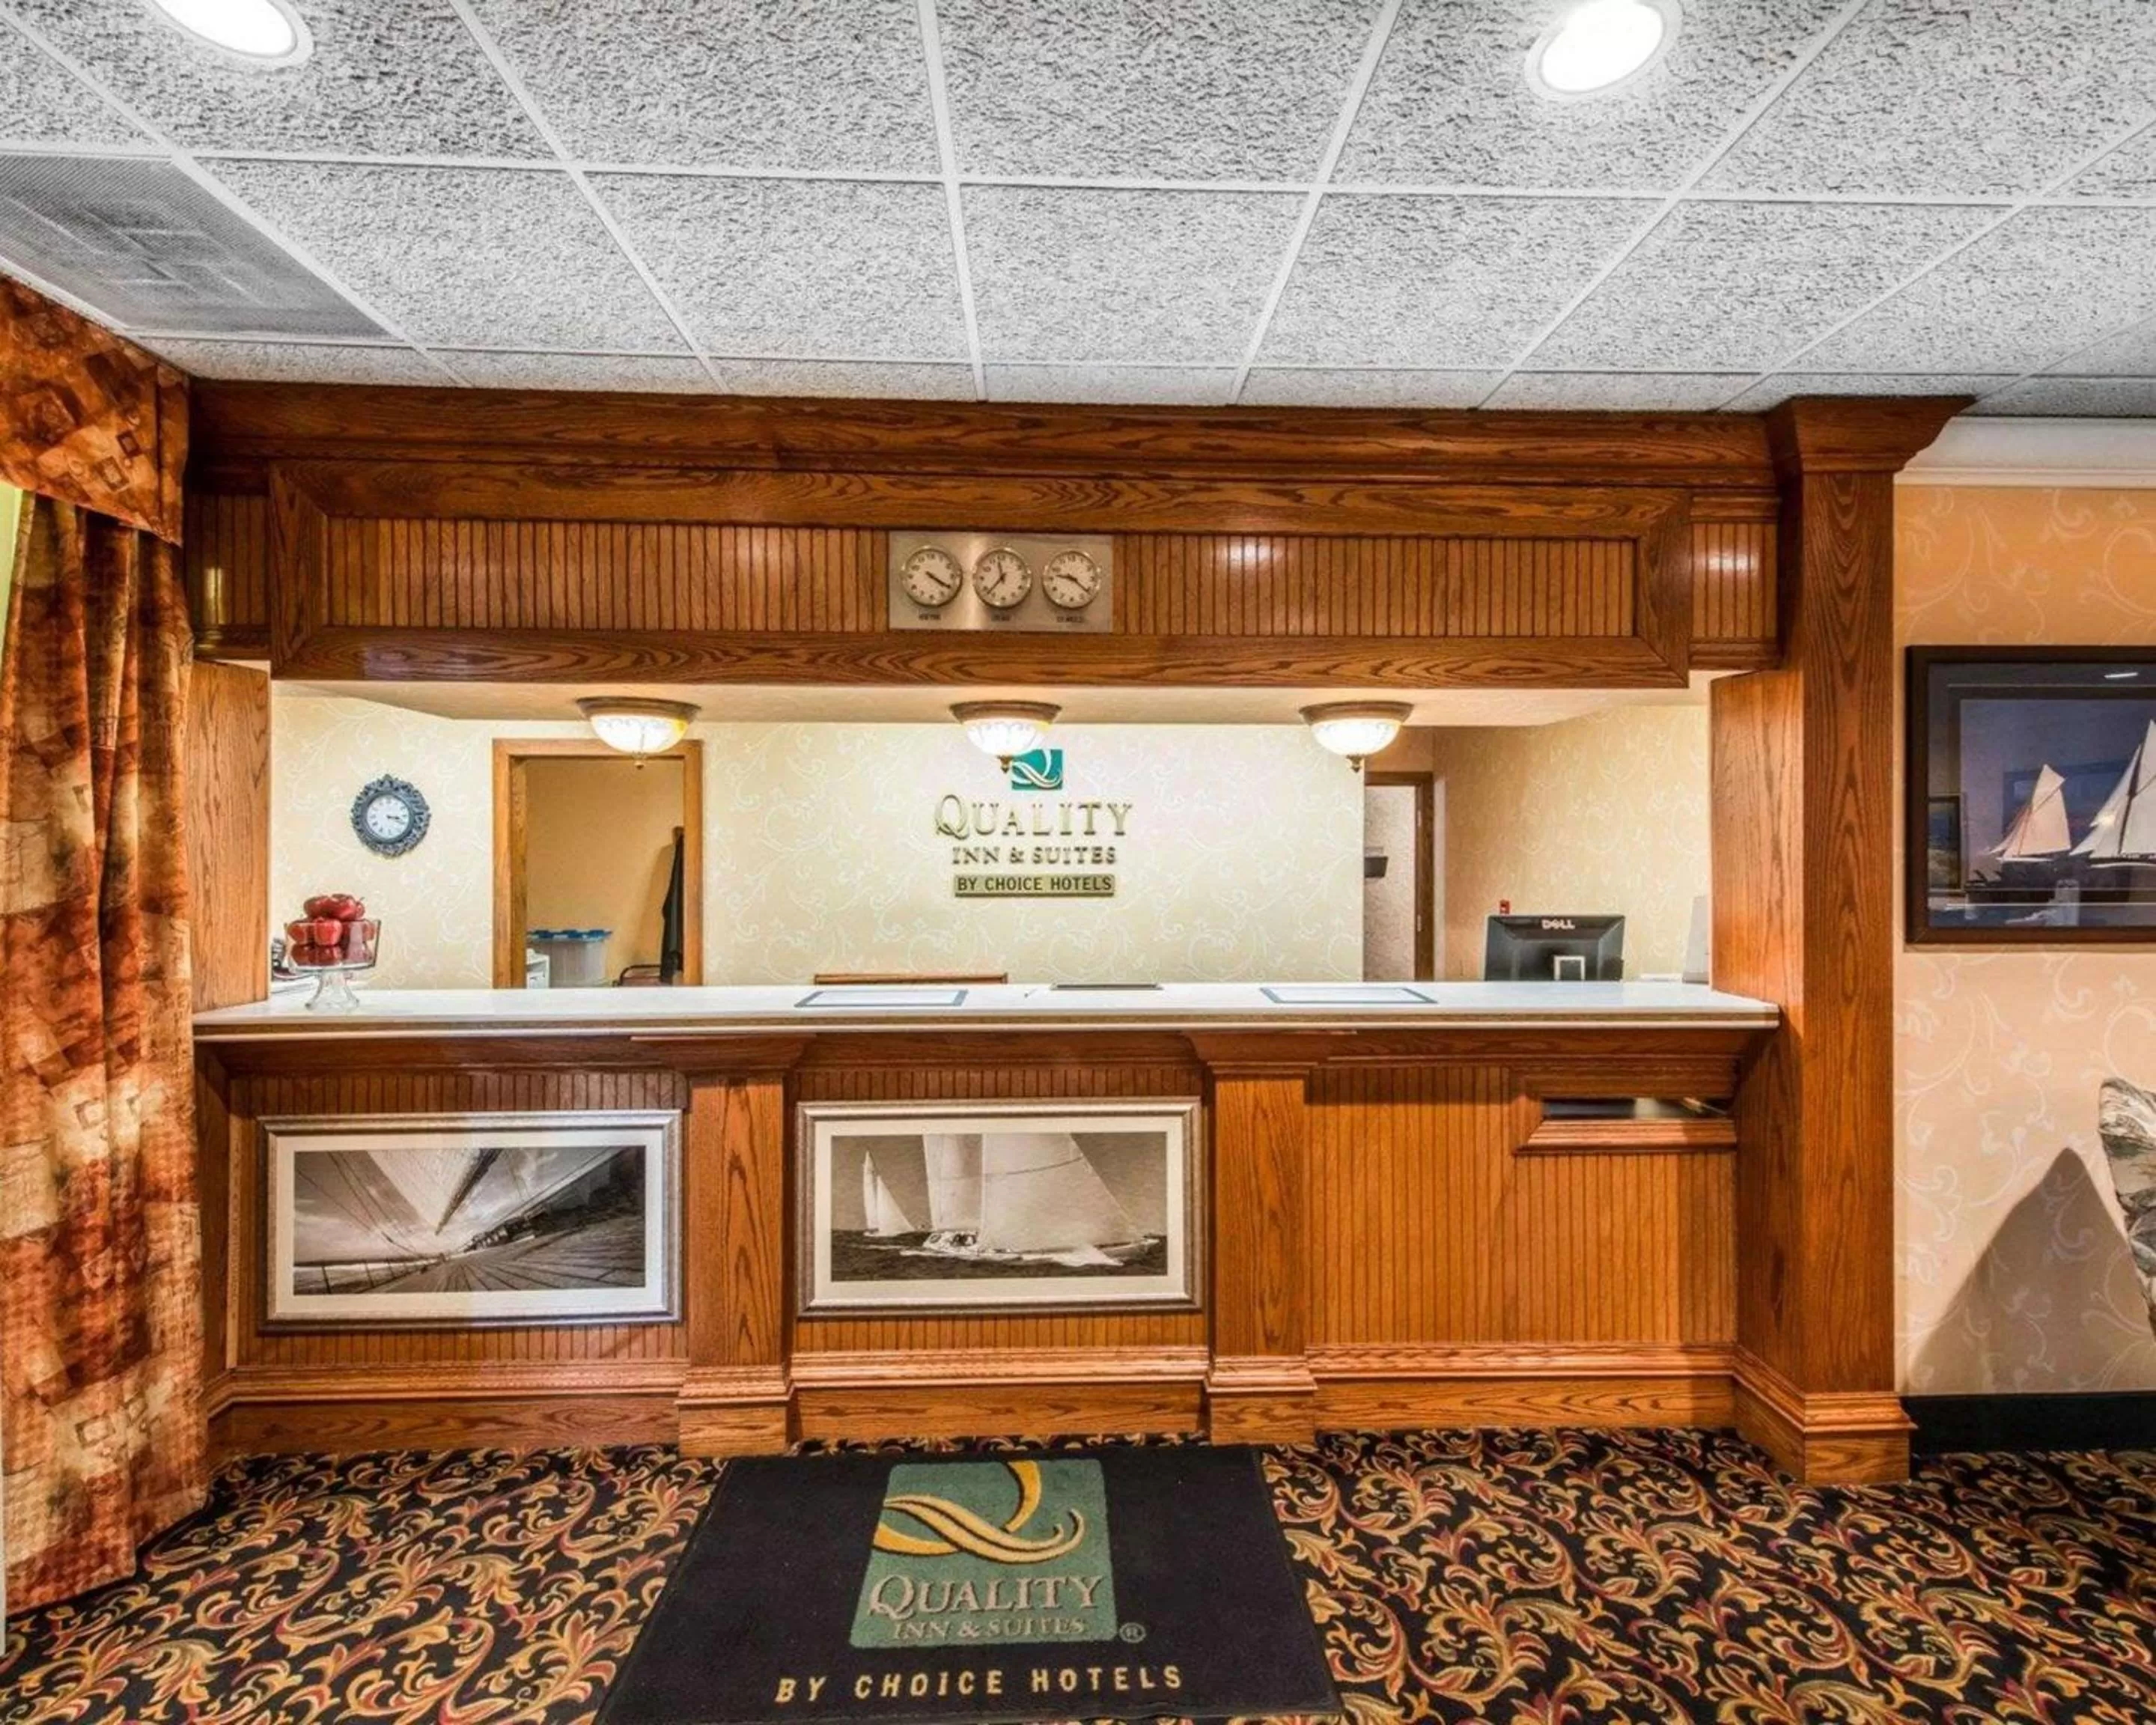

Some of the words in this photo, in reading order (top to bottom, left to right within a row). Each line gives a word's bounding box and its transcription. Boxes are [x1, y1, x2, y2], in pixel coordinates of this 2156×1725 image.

[934, 794, 1133, 840] QUALITY
[951, 847, 1000, 864] INN
[1009, 847, 1025, 864] &
[1032, 846, 1116, 864] SUITES
[957, 877, 978, 891] BY
[985, 877, 1043, 891] CHOICE
[1050, 877, 1112, 891] HOTELS
[1541, 918, 1576, 930] DELL
[868, 1574, 1104, 1619] QUALITY
[892, 1620, 948, 1640] INN
[955, 1620, 981, 1638] &
[987, 1616, 1085, 1637] SUITES
[774, 1676, 826, 1703] BY
[853, 1670, 1004, 1699] CHOICE
[1031, 1665, 1182, 1694] HOTELS
